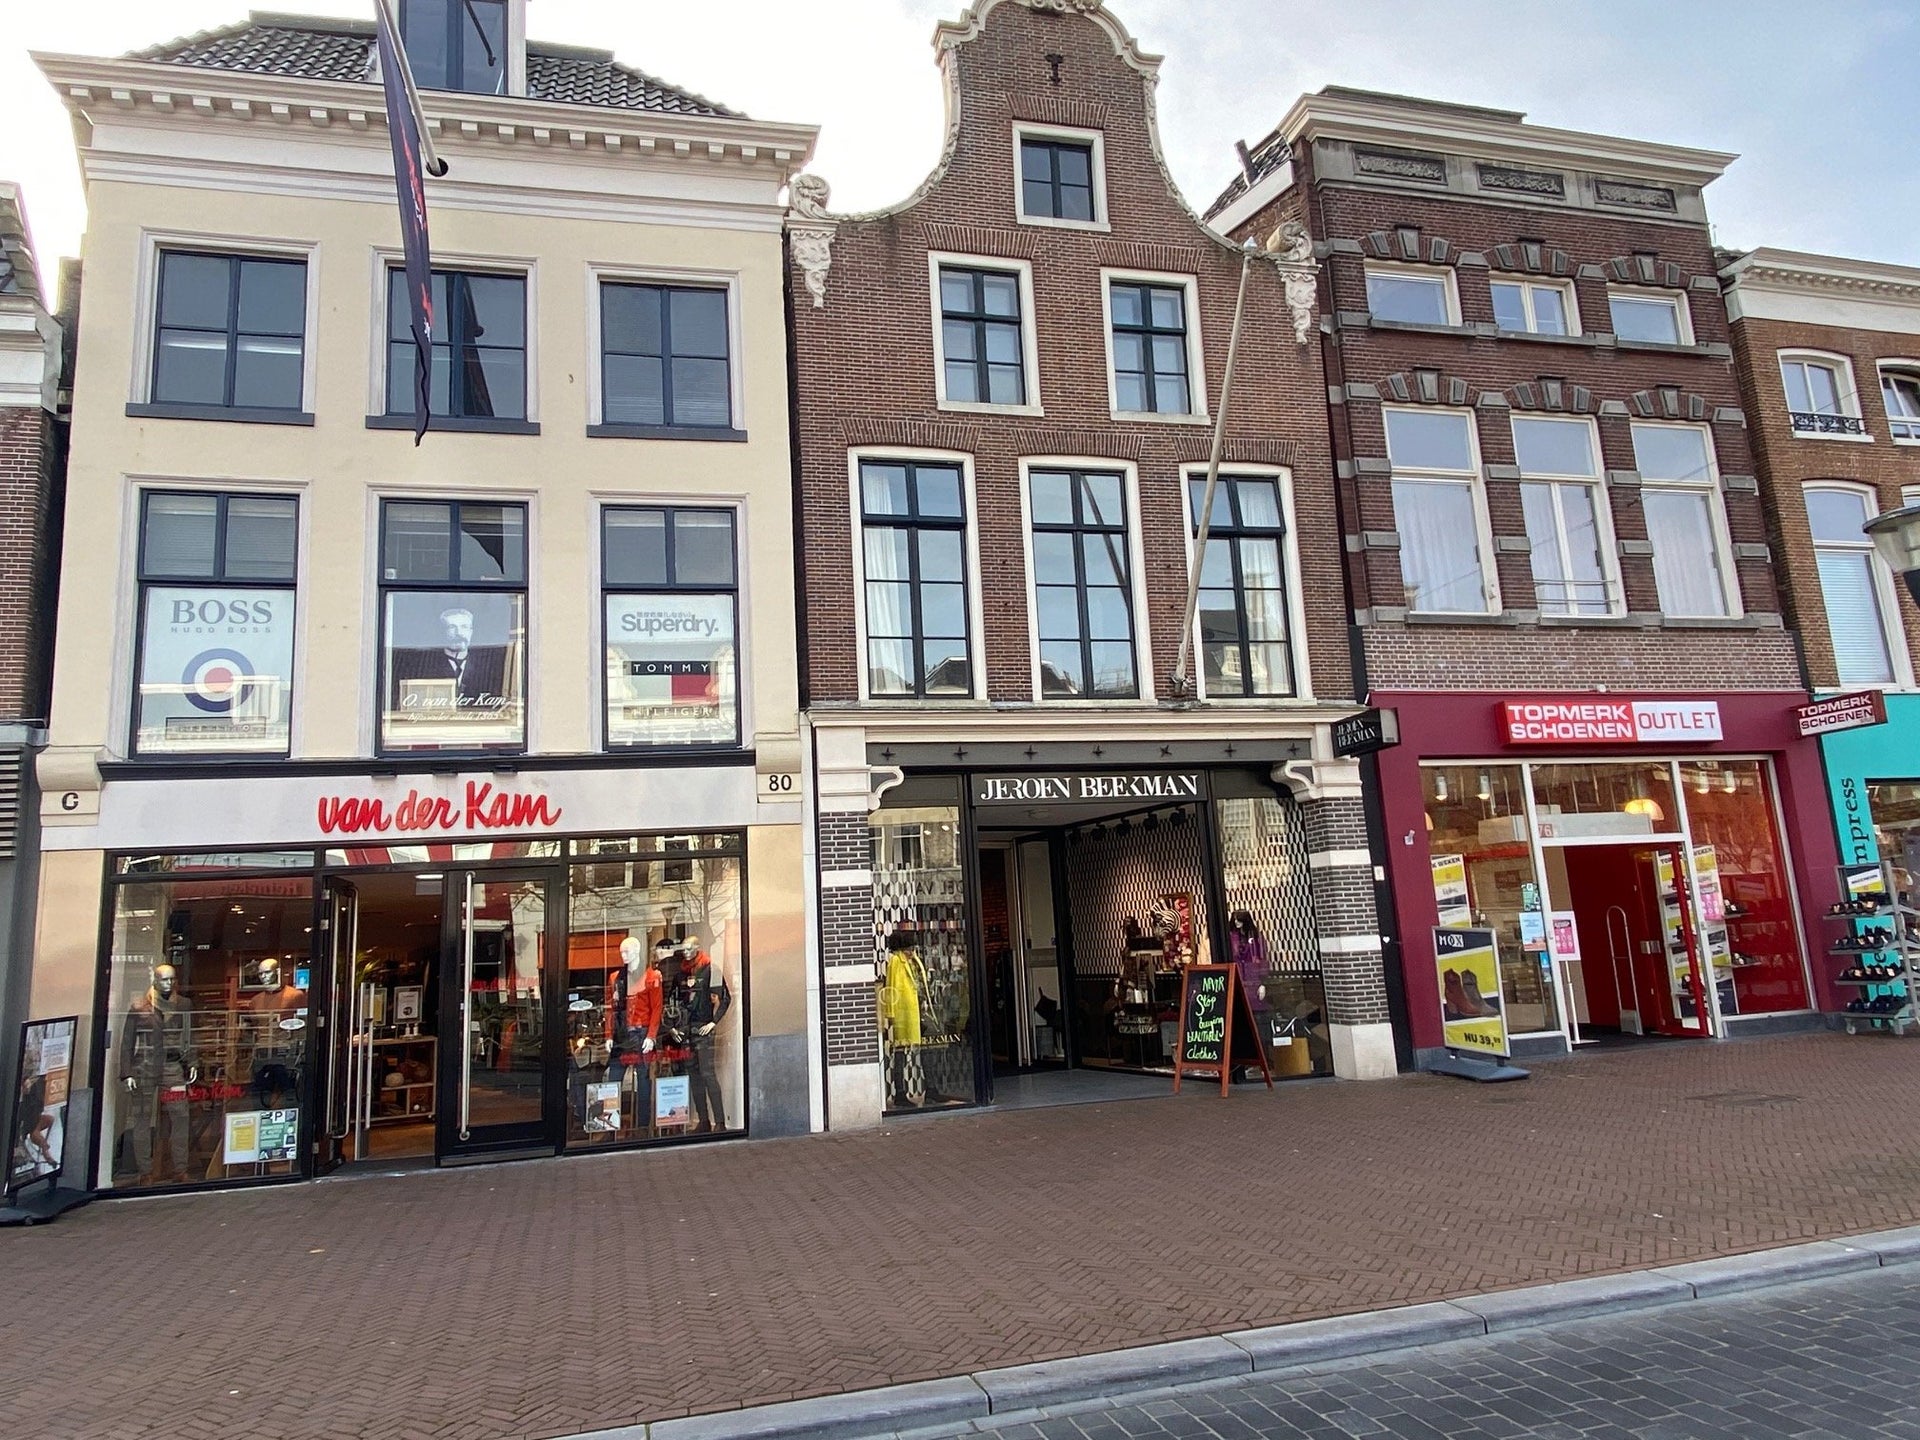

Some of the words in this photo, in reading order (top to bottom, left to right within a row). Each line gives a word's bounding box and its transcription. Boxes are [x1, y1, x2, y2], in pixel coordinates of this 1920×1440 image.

[170, 599, 272, 624] BOSS
[621, 613, 719, 637] Superdry.
[633, 664, 708, 672] TOMMY
[450, 693, 474, 706] der
[1798, 695, 1871, 717] TOPMERK
[1507, 704, 1629, 721] TOPMERK
[1638, 712, 1716, 730] OUTLET
[1801, 708, 1873, 729] SCHOENEN
[1511, 722, 1633, 739] SCHOENEN
[769, 774, 792, 791] 80
[980, 777, 1071, 800] JEROEN
[1078, 775, 1198, 798] BEEKMAN
[318, 796, 392, 833] van
[395, 790, 460, 831] der
[466, 780, 562, 829] Kam
[1195, 993, 1217, 1016] Stop
[1464, 1032, 1478, 1043] NU
